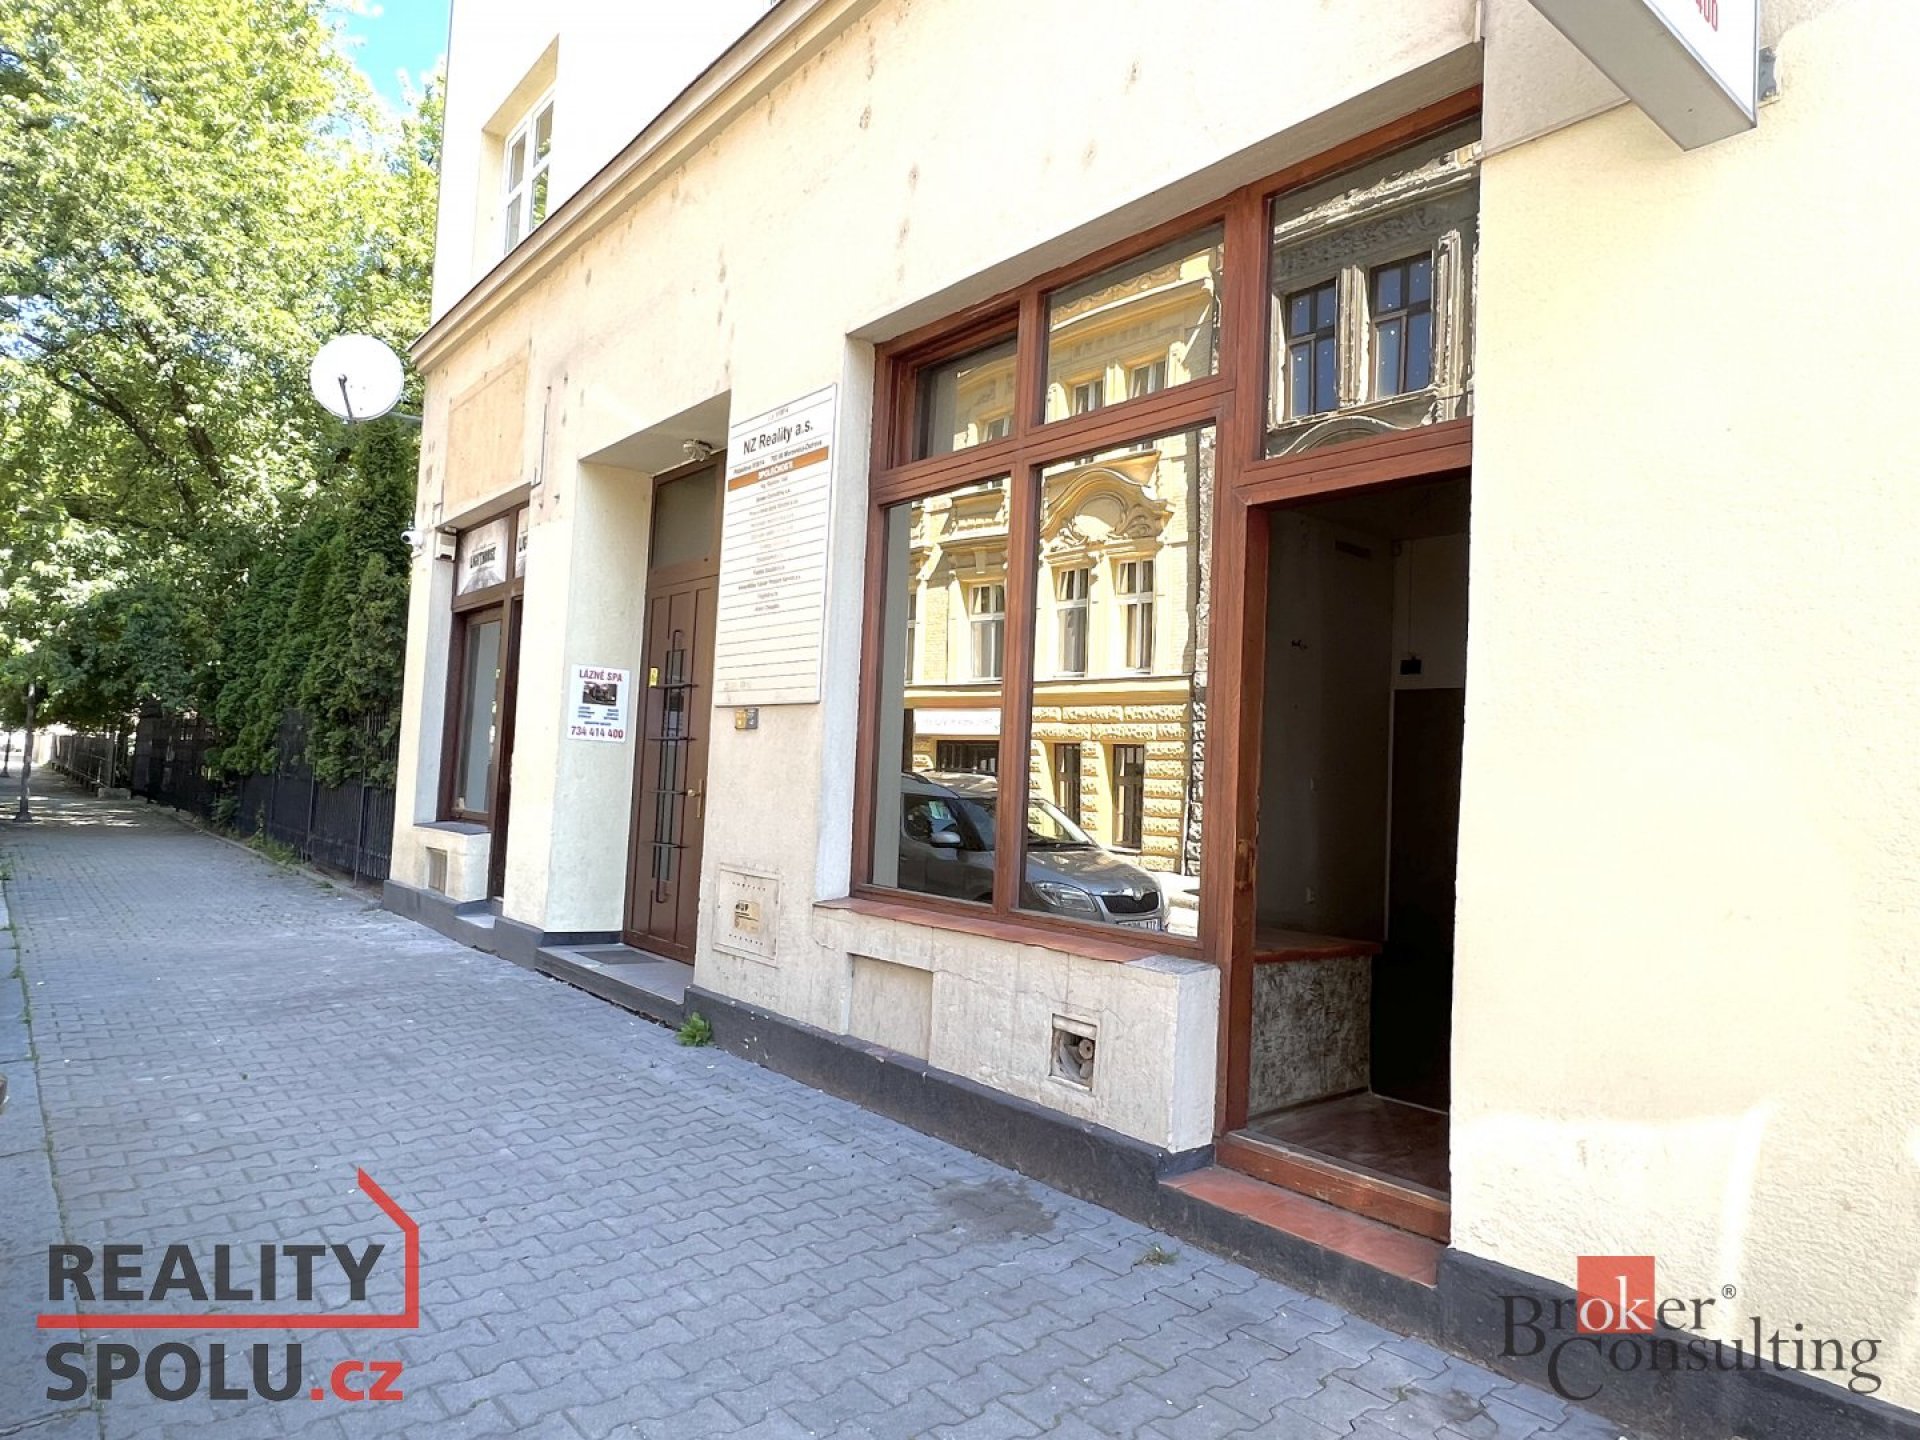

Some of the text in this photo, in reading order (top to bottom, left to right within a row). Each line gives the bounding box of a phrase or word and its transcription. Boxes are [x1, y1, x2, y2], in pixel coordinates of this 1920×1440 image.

[743, 437, 757, 455] NZ
[759, 426, 793, 449] Reality
[795, 420, 814, 437] a.s.
[607, 672, 623, 682] SPA
[571, 726, 624, 739] 734 414 400
